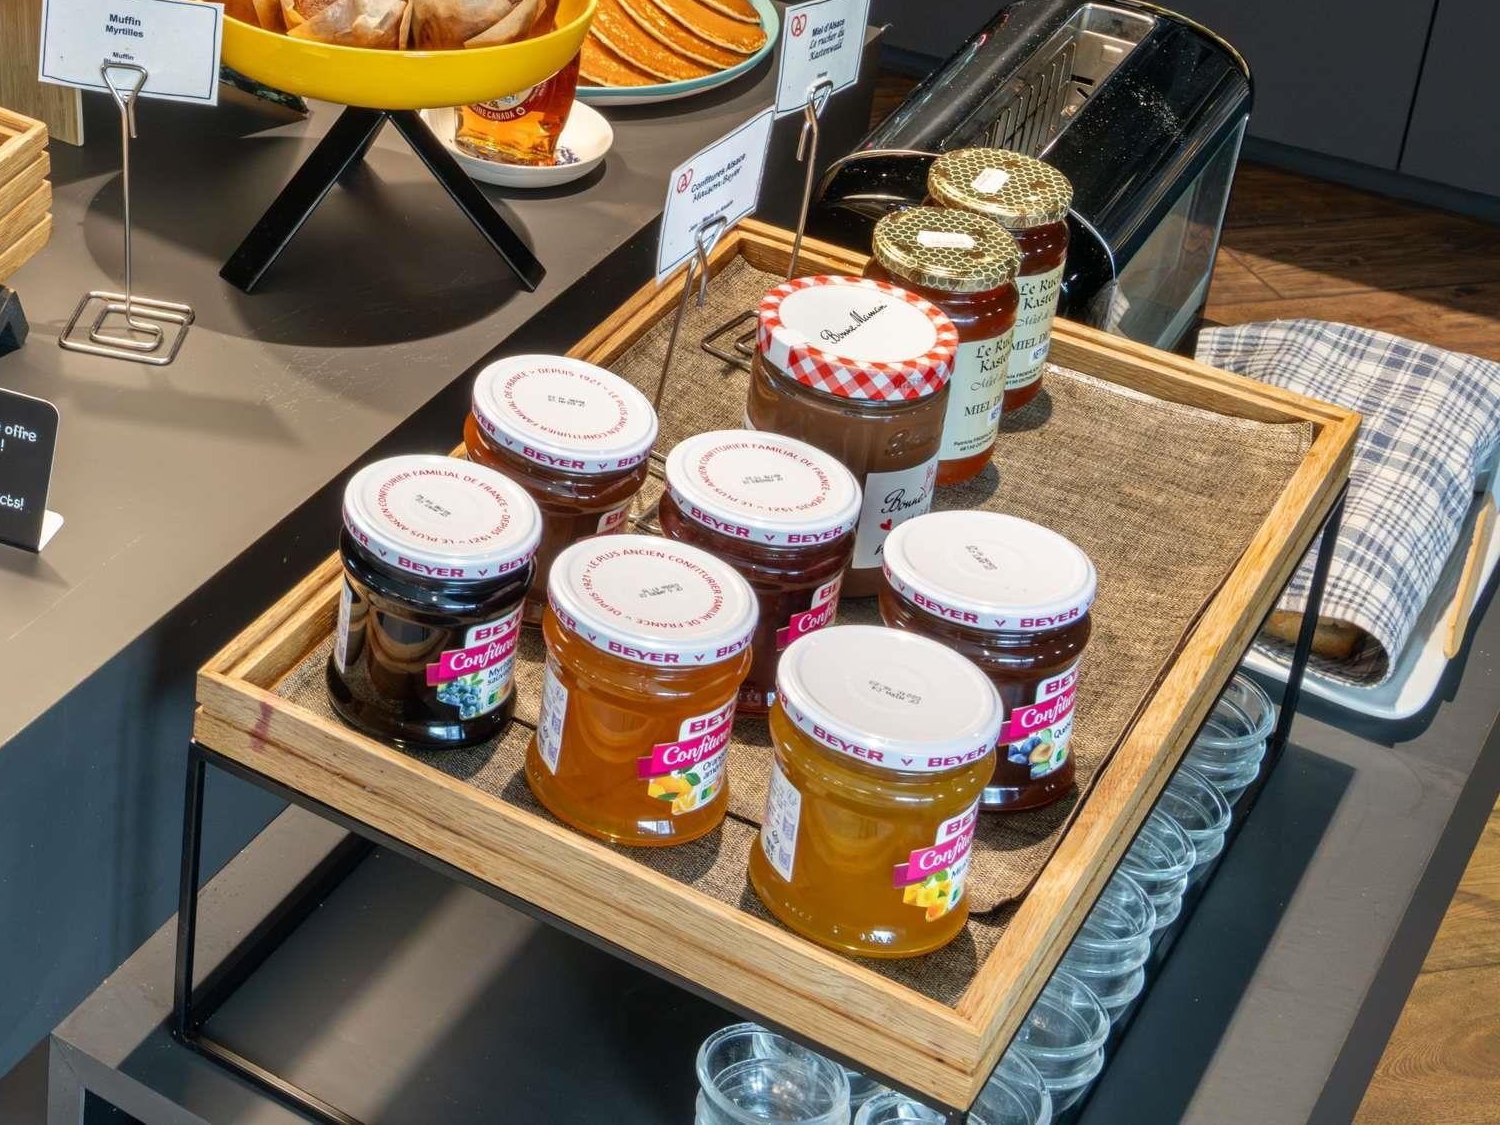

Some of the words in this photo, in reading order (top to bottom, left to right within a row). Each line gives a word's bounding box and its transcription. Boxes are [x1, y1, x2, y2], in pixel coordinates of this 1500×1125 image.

[109, 13, 142, 26] Muffin
[812, 26, 824, 36] Miel
[823, 18, 845, 33] d'Alsace
[105, 25, 144, 38] Myrtilles
[112, 51, 134, 61] Muffin
[487, 110, 515, 121] CANADA
[691, 167, 726, 194] Confitures
[726, 153, 746, 171] Alsace
[693, 183, 720, 203] Maison
[722, 166, 743, 186] Beyer
[1020, 282, 1036, 295] Le
[820, 325, 856, 345] Bonne
[848, 303, 888, 328] Maman
[975, 344, 992, 359] Le
[504, 390, 514, 400] DE
[537, 368, 575, 377] DEPUIS
[579, 374, 601, 386] 1921
[964, 401, 990, 416] MIEL
[4, 424, 37, 442] offre
[0, 439, 5, 451] !
[523, 446, 585, 470] BEYER
[752, 443, 800, 461] FAMILIAL
[800, 458, 814, 467] DE
[812, 466, 831, 491] FRANCE
[412, 469, 461, 481] FAMILIAL
[463, 475, 479, 485] DE
[377, 470, 412, 508] CONFITURIER
[478, 482, 508, 508] FRANCE
[378, 507, 410, 532] ANCIEN
[492, 514, 511, 536] DEPUIS
[690, 507, 750, 538] BEYER
[787, 526, 843, 544] BEYER
[597, 550, 621, 563] PLUS
[622, 548, 665, 559] ANCIEN
[397, 556, 465, 578] BEYER
[588, 558, 600, 570] LE
[581, 574, 593, 591] 1921
[668, 555, 722, 595] CONFITURIER
[589, 591, 623, 617] DEPUIS
[913, 592, 980, 624] BEYER
[1019, 607, 1080, 628] BEYER
[635, 618, 684, 629] FRANCE
[686, 618, 701, 627] DE
[608, 641, 680, 663] BEYER
[813, 724, 885, 763] BEYER
[927, 743, 988, 768] BEYER
